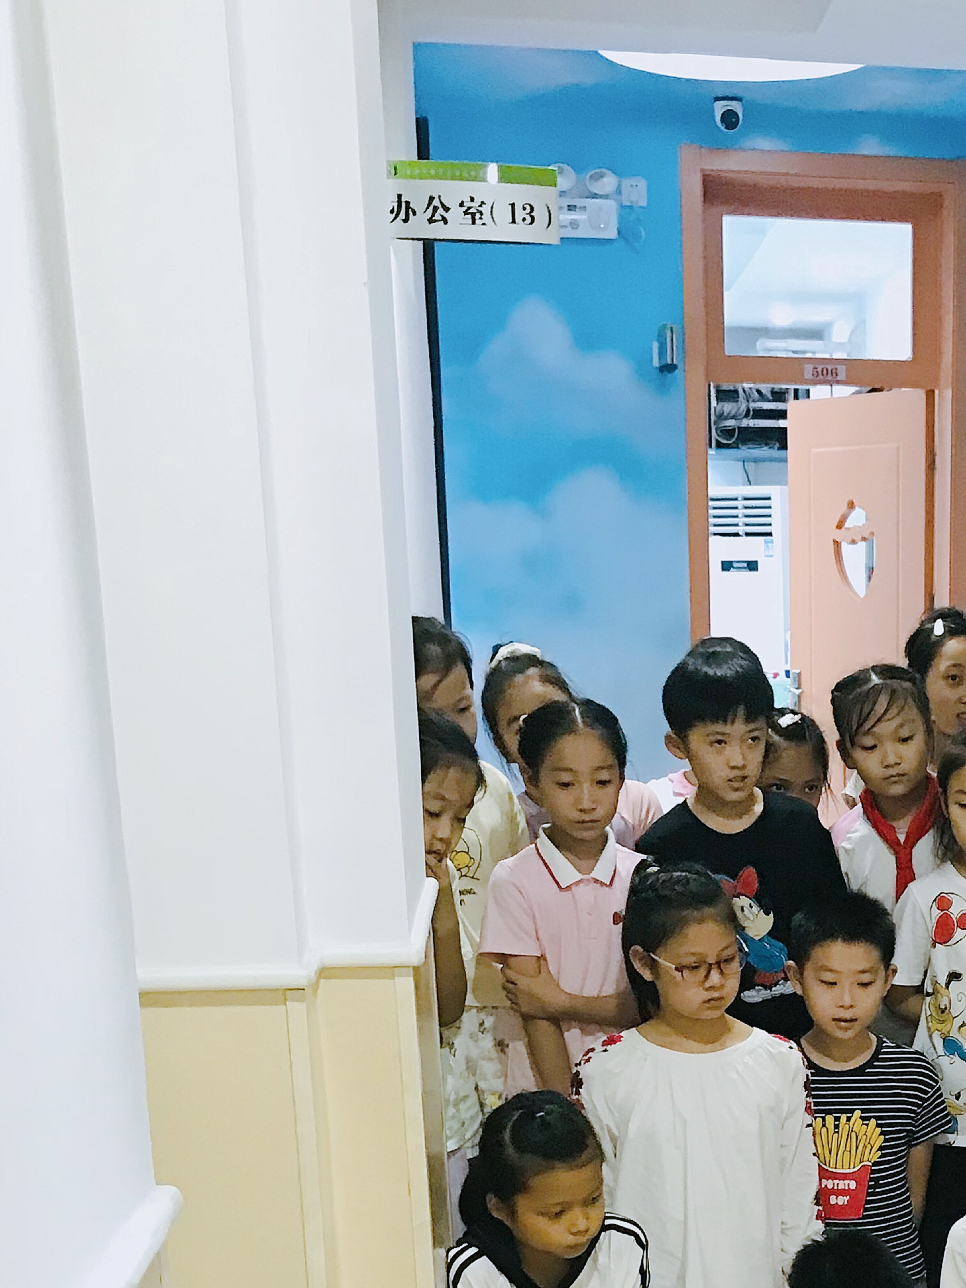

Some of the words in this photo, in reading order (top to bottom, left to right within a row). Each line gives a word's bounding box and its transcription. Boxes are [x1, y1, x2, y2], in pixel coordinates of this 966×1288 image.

[811, 365, 839, 379] 506
[821, 1178, 857, 1190] POTATO
[829, 1194, 850, 1206] BOY
